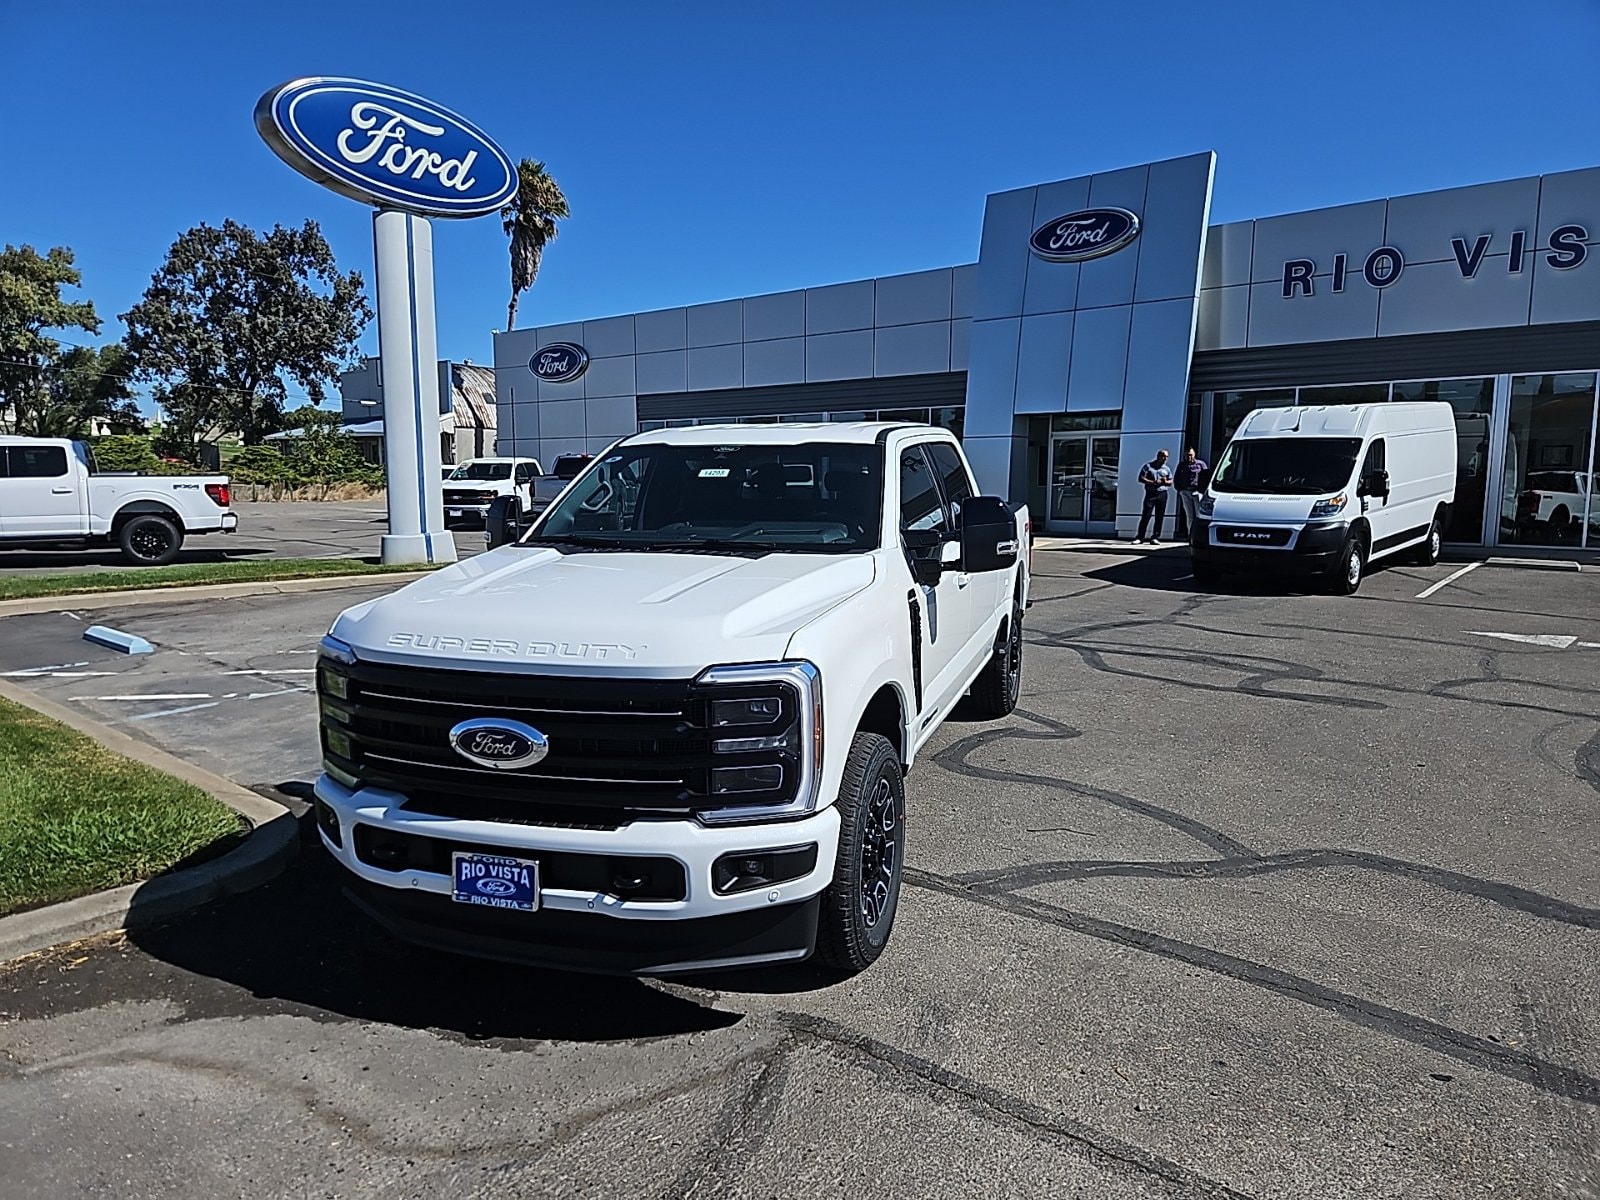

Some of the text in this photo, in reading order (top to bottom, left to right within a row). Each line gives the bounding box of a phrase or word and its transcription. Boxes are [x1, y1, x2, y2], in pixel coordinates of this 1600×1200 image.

[337, 102, 479, 192] Ford
[1050, 218, 1109, 249] Ford
[1281, 224, 1589, 298] RIO VIS
[538, 352, 569, 374] Ford
[386, 632, 647, 660] SUPER DUTY
[471, 732, 518, 756] Ford
[473, 855, 517, 866] FORD
[461, 862, 531, 889] RIO VISTA
[486, 881, 506, 892] Ford
[471, 895, 488, 904] RIO
[490, 897, 519, 909] VISTA
